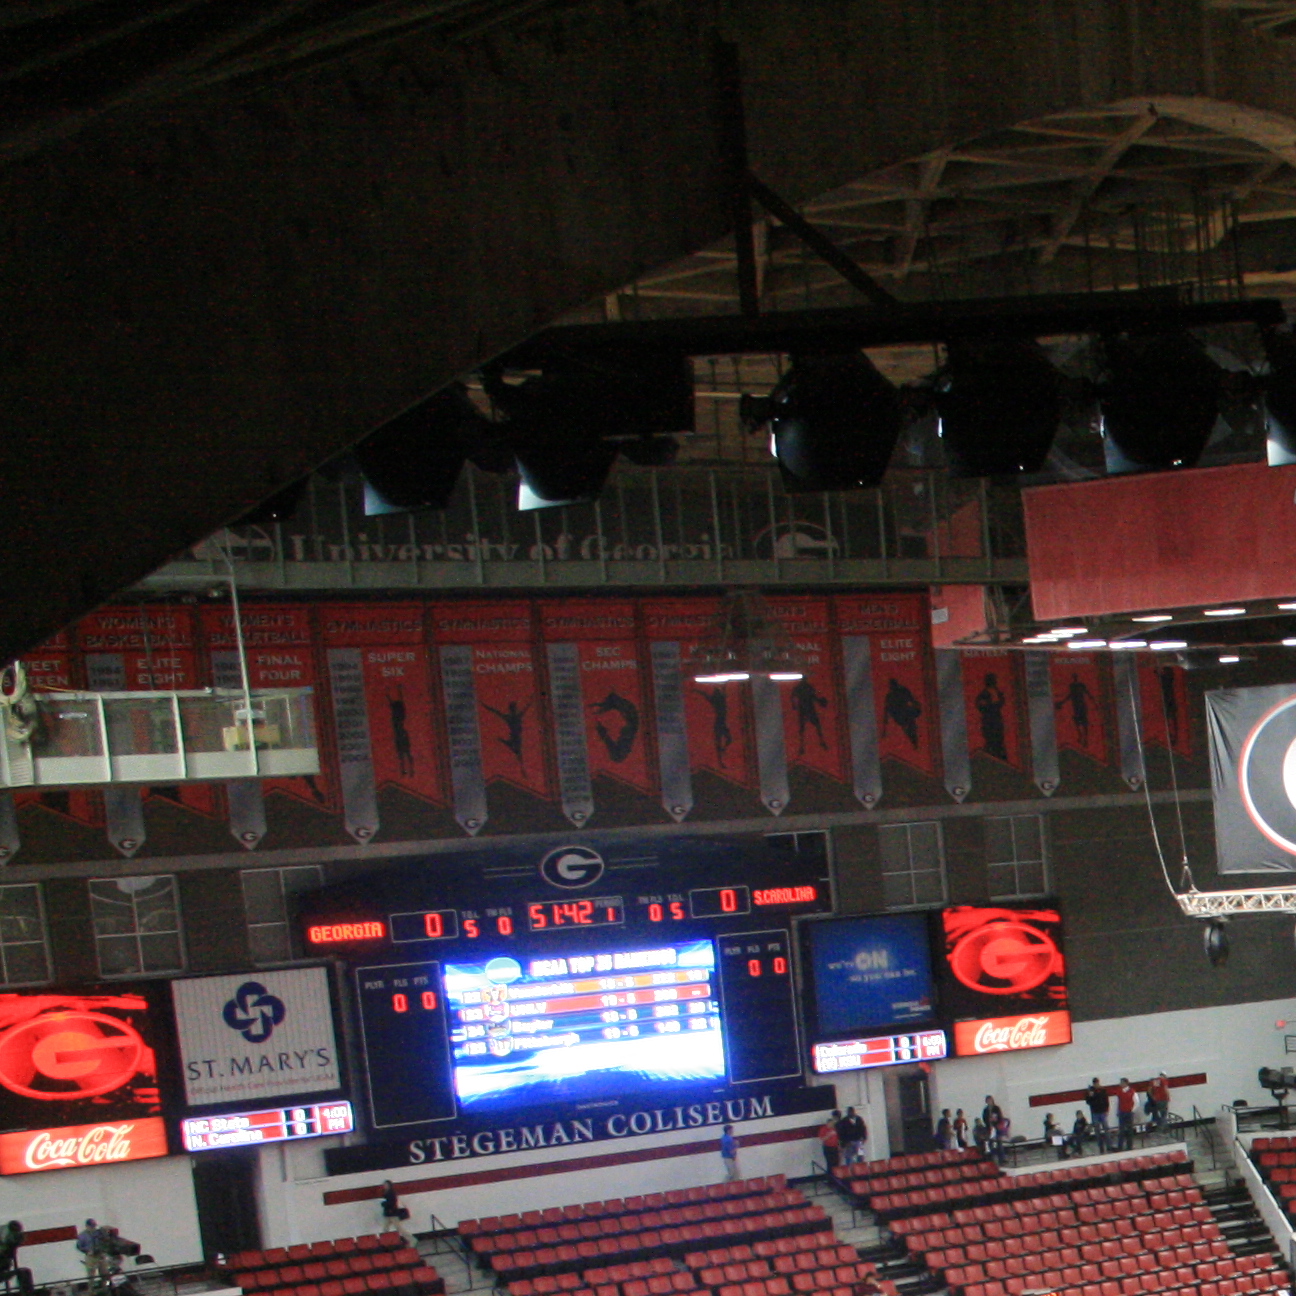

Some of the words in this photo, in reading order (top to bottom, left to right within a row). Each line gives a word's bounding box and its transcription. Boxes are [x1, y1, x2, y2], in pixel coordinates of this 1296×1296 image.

[137, 657, 181, 669] ELITE
[258, 654, 302, 667] FINAL
[368, 651, 416, 664] SUPER
[138, 672, 185, 685] EIGHT
[259, 669, 301, 682] FOUR
[720, 889, 737, 912] 0
[529, 900, 594, 929] 51:42
[606, 907, 615, 922] 1
[649, 904, 662, 922] 0
[670, 902, 684, 920] 5
[308, 922, 385, 944] GEORGIA
[424, 913, 443, 937] 0
[463, 920, 479, 938] 5
[497, 916, 513, 935] 0
[748, 959, 762, 977] 0
[773, 957, 787, 974] 0
[855, 949, 888, 970] ON
[392, 994, 408, 1013] 0
[421, 991, 436, 1010] 0
[975, 1017, 1049, 1053] Coca-Cola
[187, 1060, 225, 1081] ST.
[231, 1048, 331, 1077] MARY'S
[295, 1109, 306, 1121] 0
[322, 1106, 348, 1119] 4:00
[189, 1120, 210, 1134] NC
[210, 1116, 250, 1132] State
[296, 1122, 307, 1135] 0
[409, 1117, 595, 1164] STEGEMAN
[607, 1095, 775, 1137] COLISEUM
[25, 1124, 135, 1169] Coca-Cola
